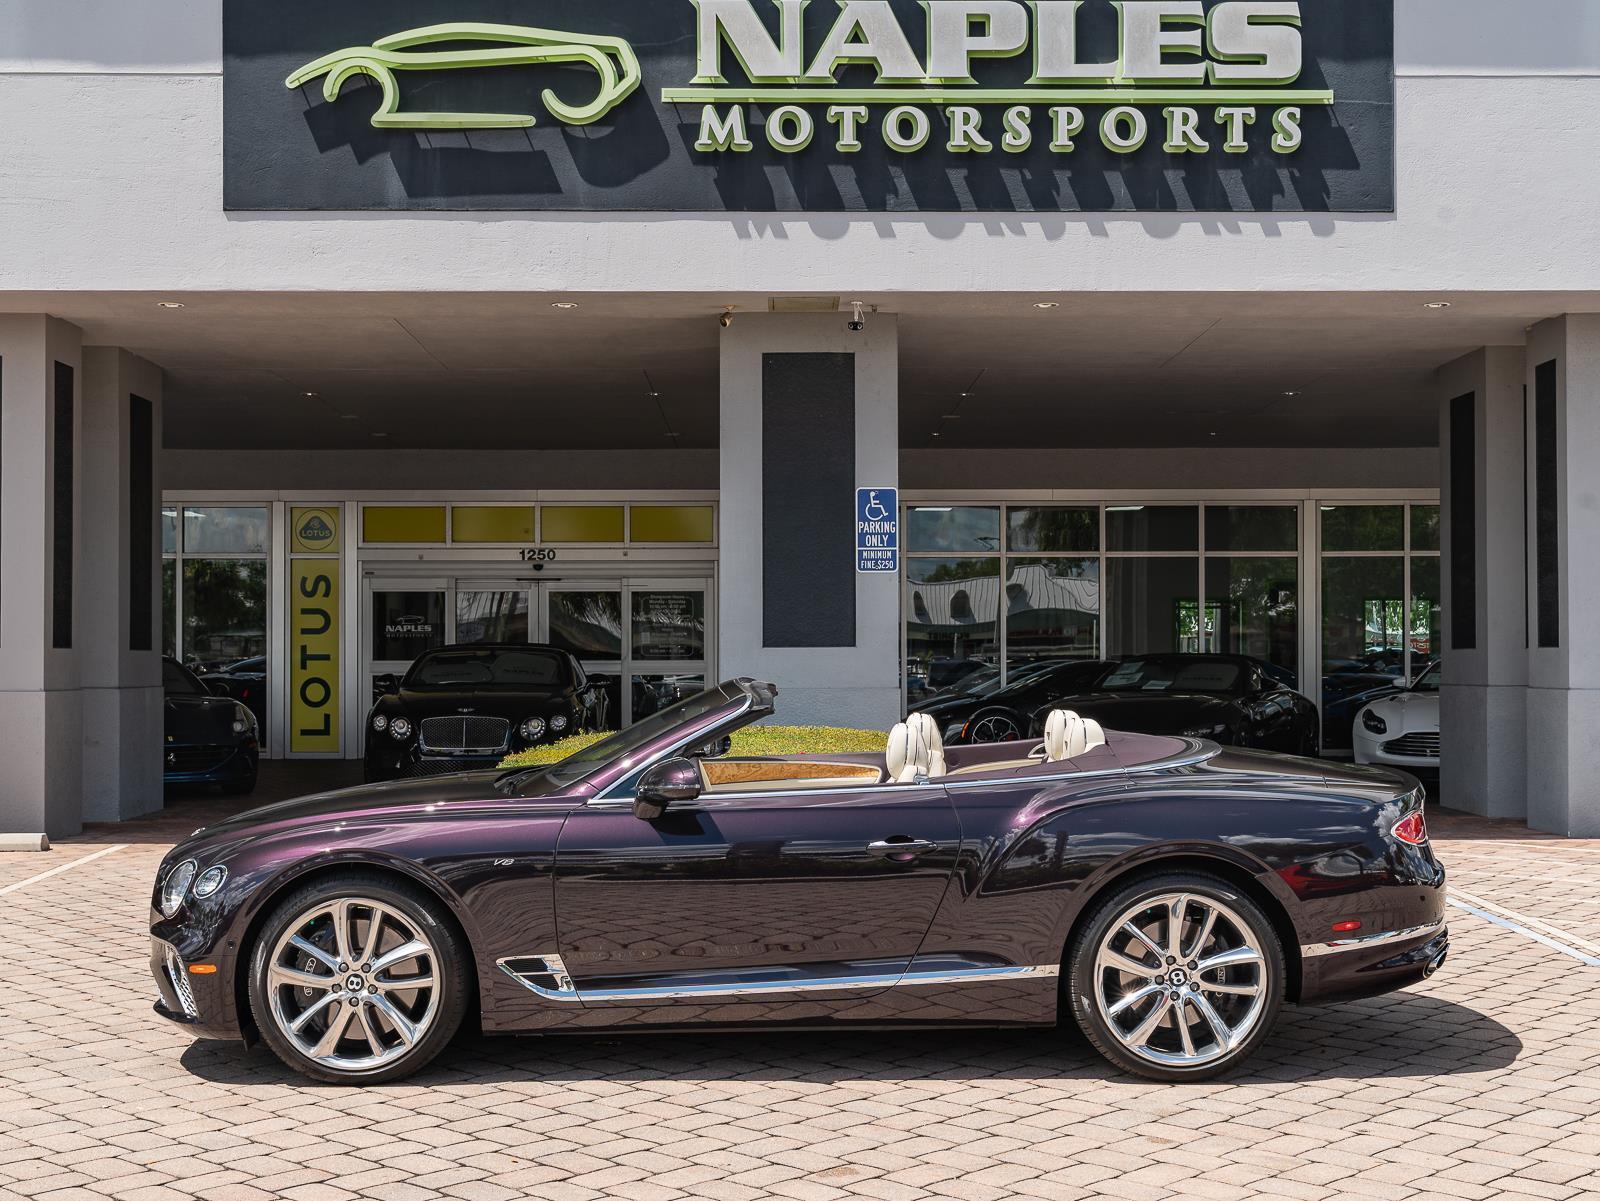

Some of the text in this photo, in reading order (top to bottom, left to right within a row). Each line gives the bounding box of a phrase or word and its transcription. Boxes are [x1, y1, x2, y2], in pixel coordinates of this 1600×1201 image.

[690, 0, 1302, 84] NAPLES
[695, 104, 1302, 153] MOTORSPORTS
[858, 522, 896, 533] PARKING
[865, 535, 889, 546] ONLY
[519, 549, 556, 560] 1250
[862, 551, 892, 559] MINIMUM
[861, 560, 894, 569] FINE $250
[300, 575, 331, 736] LOTUS
[494, 858, 515, 866] V8
